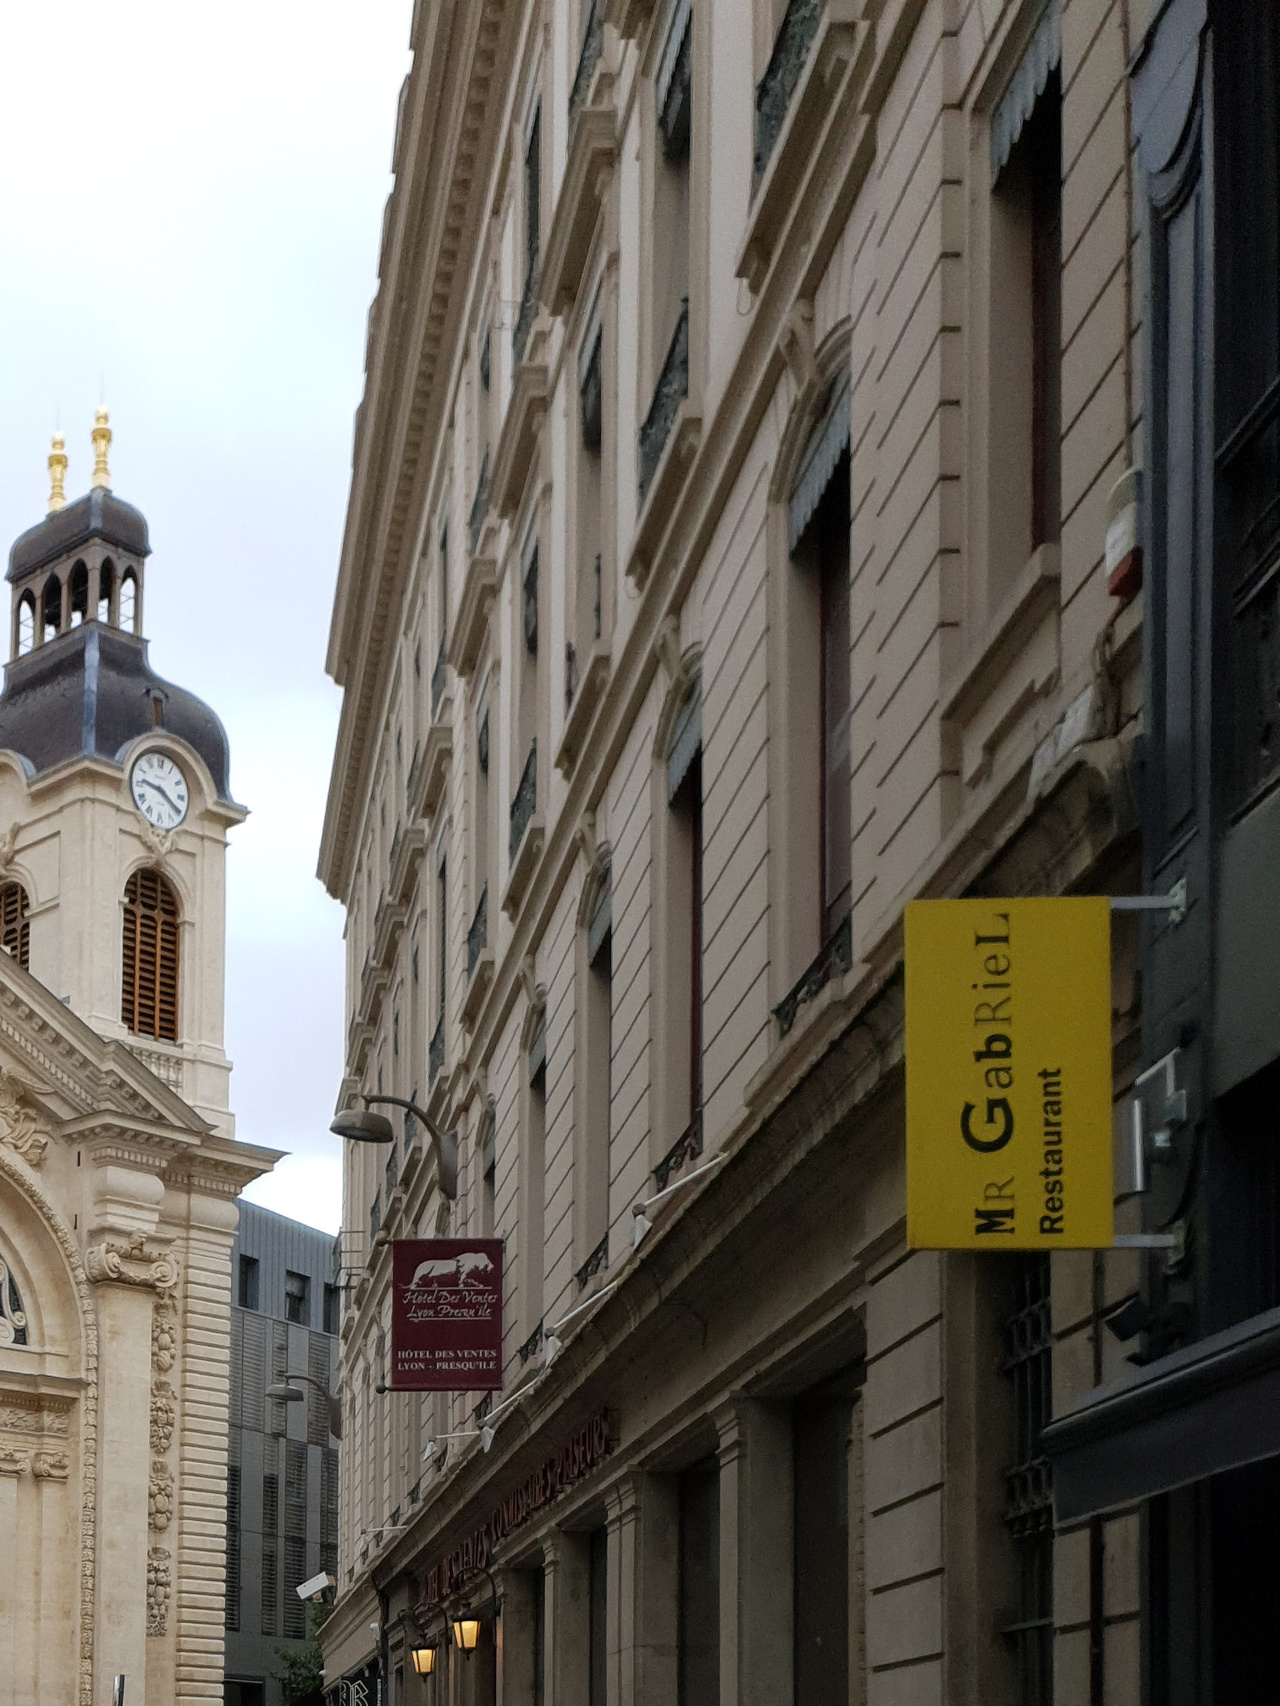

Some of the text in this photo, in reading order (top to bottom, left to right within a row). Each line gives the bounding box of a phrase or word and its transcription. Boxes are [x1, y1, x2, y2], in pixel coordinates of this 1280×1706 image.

[1036, 1067, 1065, 1236] Restaurant
[463, 1290, 498, 1304] Ventes
[406, 1305, 435, 1322] Lyon
[398, 1349, 497, 1359] HÔTEL DES VENTES
[398, 1362, 426, 1371] LYON
